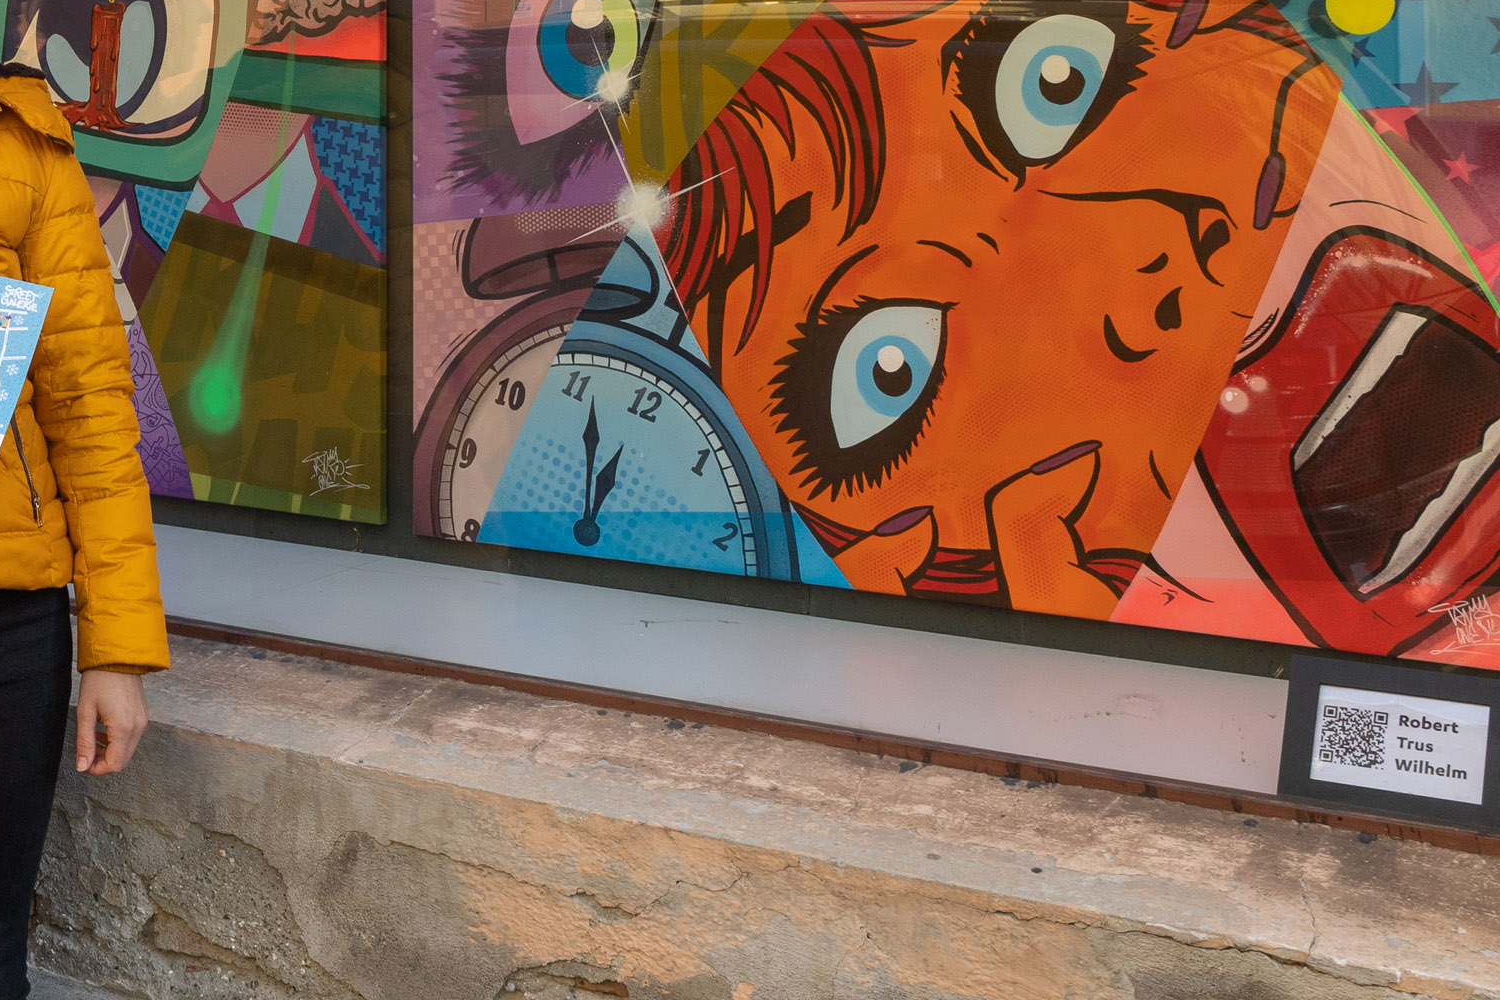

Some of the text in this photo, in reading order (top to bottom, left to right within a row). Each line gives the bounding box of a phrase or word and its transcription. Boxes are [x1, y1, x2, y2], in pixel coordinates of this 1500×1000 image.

[0, 295, 38, 312] GALERIE
[4, 284, 40, 302] STREET
[494, 378, 526, 412] 10
[561, 370, 592, 403] 11
[626, 386, 663, 423] 12
[458, 438, 478, 469] 9
[690, 448, 712, 477] 1
[460, 518, 481, 543] 8
[712, 522, 739, 552] 2
[1398, 714, 1460, 734] Robert
[1396, 736, 1434, 752] Trus
[1394, 758, 1468, 780] Wilhelm
